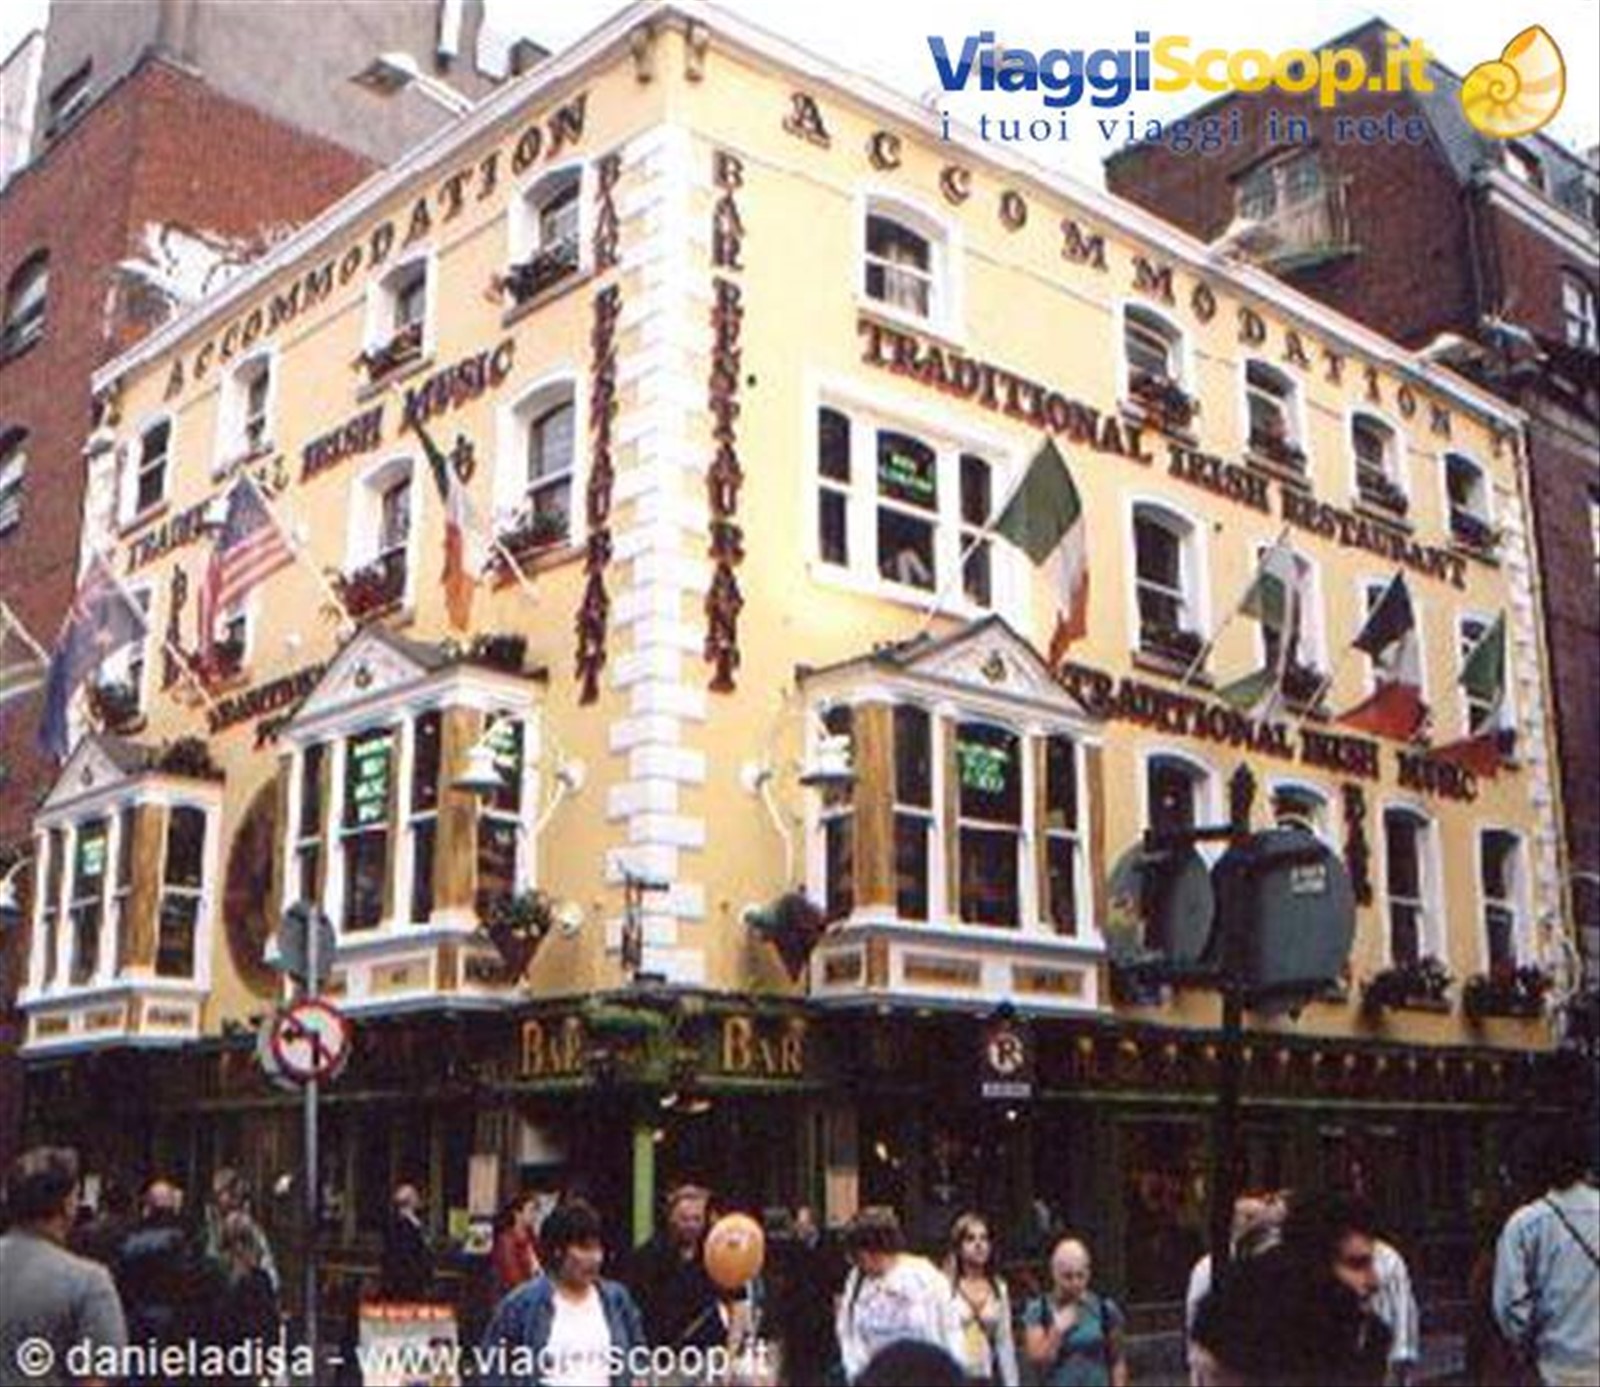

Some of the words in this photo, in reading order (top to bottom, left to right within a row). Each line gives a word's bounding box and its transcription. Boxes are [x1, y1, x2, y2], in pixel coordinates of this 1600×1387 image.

[164, 93, 589, 401] ACCOMMODATION
[593, 152, 621, 273] BAR
[711, 150, 744, 271] BAR
[781, 91, 1452, 440] ACCOMMODATION
[300, 402, 385, 483] IRISH
[400, 338, 516, 432] MUSIC
[857, 318, 1152, 465] TRADITIONAL
[1167, 444, 1272, 515] IRISH
[1280, 485, 1468, 591] RESTAURANT
[703, 276, 745, 692] RESTAURANT
[1061, 661, 1296, 760] TRADITIONAL
[722, 1016, 803, 1073] BAR
